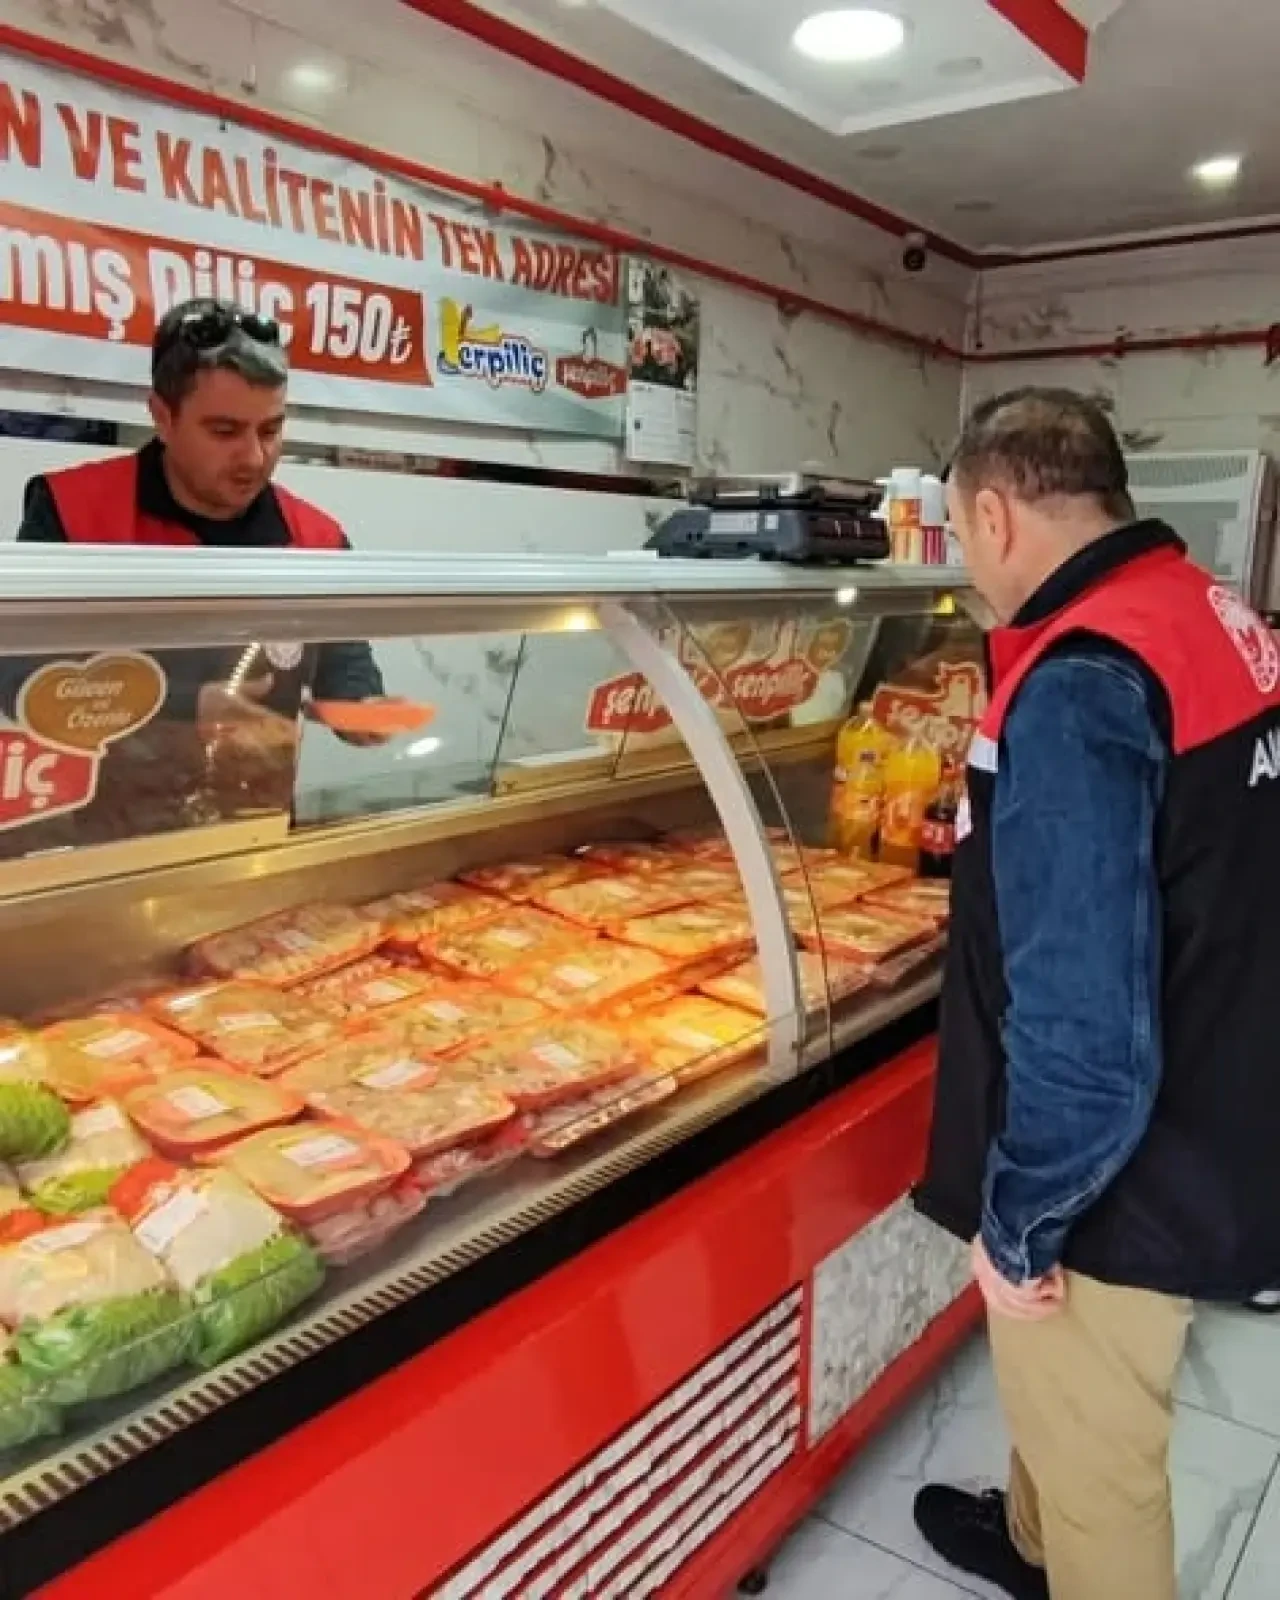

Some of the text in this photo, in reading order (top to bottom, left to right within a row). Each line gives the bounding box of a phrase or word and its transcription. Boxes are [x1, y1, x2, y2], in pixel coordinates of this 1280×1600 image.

[55, 102, 147, 192] VE
[155, 130, 424, 261] KALİTENİN
[427, 212, 504, 283] TEK
[0, 740, 58, 810] iç
